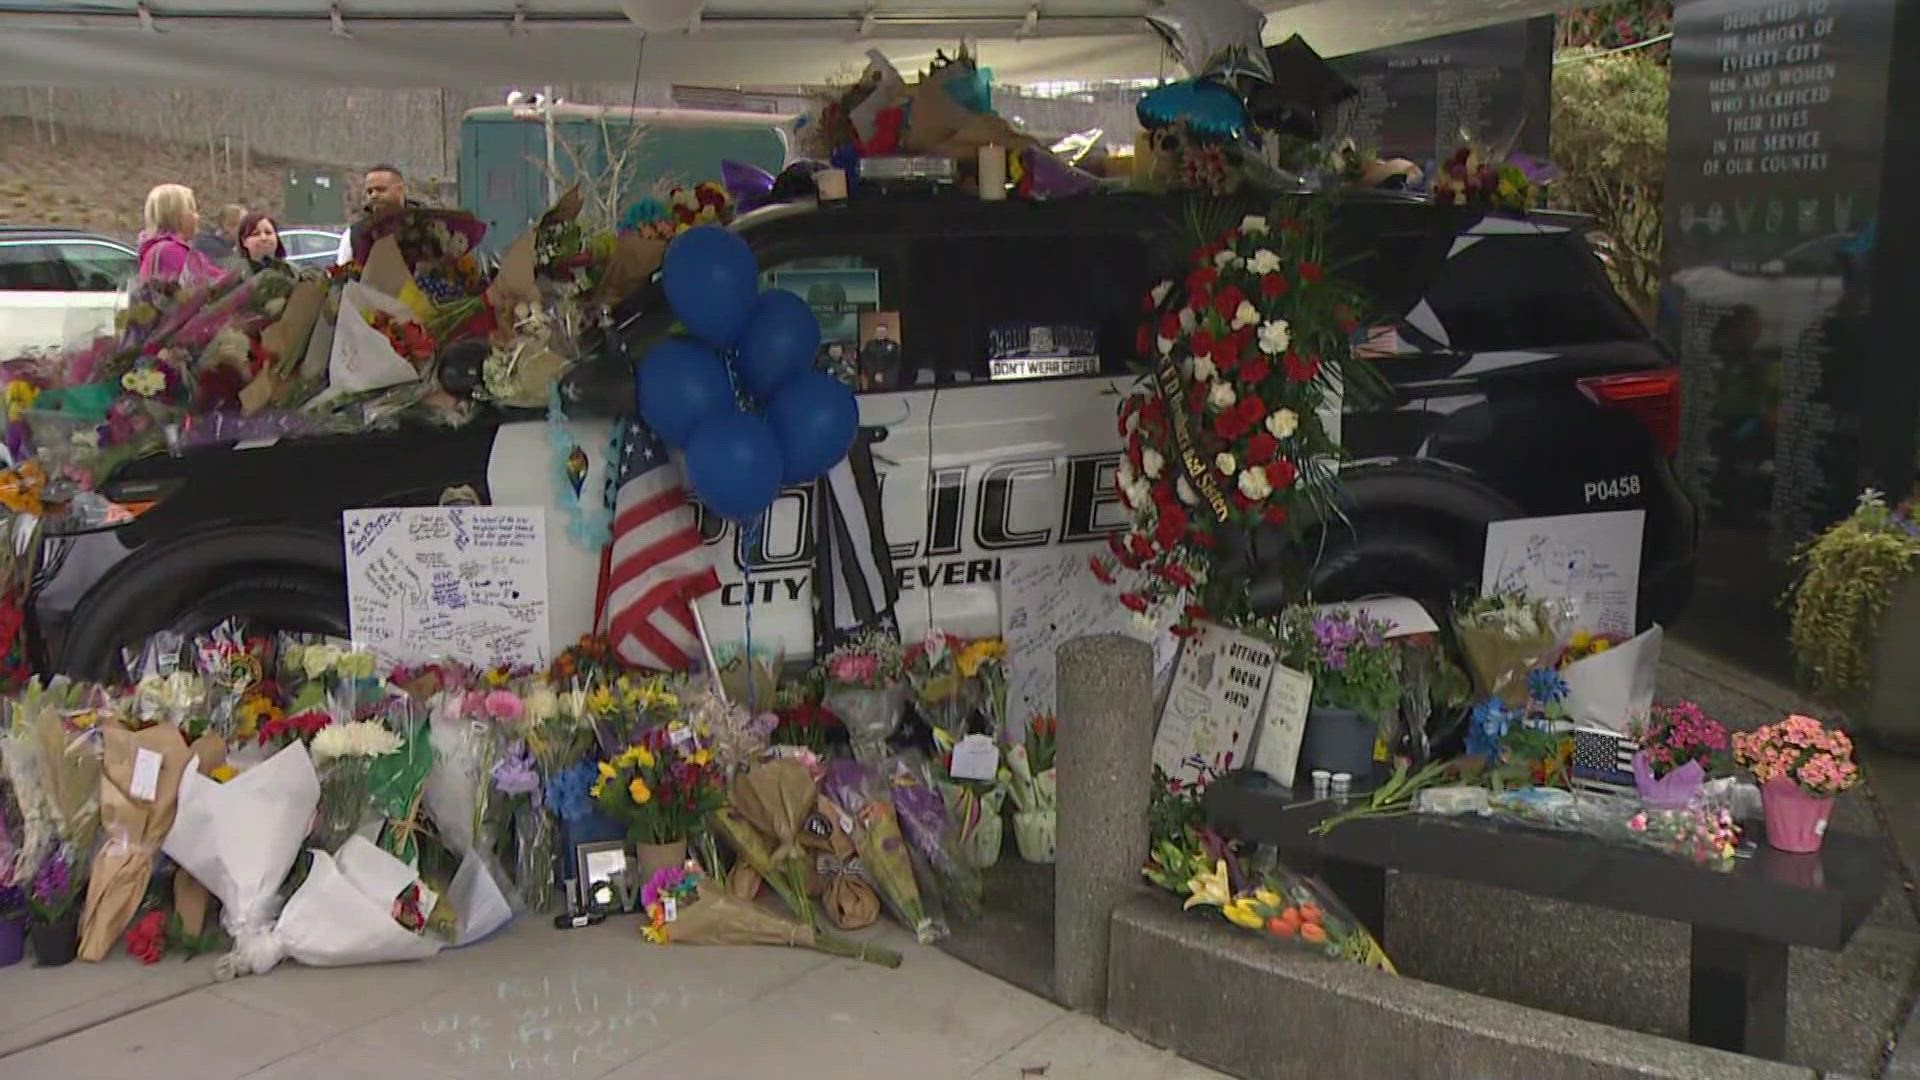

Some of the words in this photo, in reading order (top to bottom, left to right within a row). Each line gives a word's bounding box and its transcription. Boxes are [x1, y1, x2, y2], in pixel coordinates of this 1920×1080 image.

[1722, 3, 1801, 31] DEDICATED
[1807, 0, 1830, 15] TO
[1716, 36, 1738, 50] THE
[1746, 23, 1806, 47] MEMORY
[1813, 18, 1834, 36] OF
[1722, 50, 1779, 73] EVERETT
[1785, 44, 1823, 63] CITY
[1709, 78, 1737, 93] MEN
[1743, 73, 1772, 90] AND
[1779, 64, 1836, 86] WOMEN
[1710, 98, 1743, 113] WHO
[1750, 86, 1831, 110] SACRIFICED
[1727, 115, 1762, 134] THEIR
[1769, 111, 1809, 129] LIVES
[1712, 140, 1728, 154] IN
[1734, 137, 1757, 153] THE
[1763, 131, 1820, 150] SERVICE
[1703, 159, 1721, 176] OF
[1726, 158, 1753, 175] OUR
[1760, 153, 1829, 173] COUNTRY
[1027, 359, 1062, 374] WEAR
[1197, 472, 1229, 524] Sisters
[1583, 474, 1641, 503] P0458
[688, 450, 1135, 573] OICE
[721, 574, 808, 607] CITY
